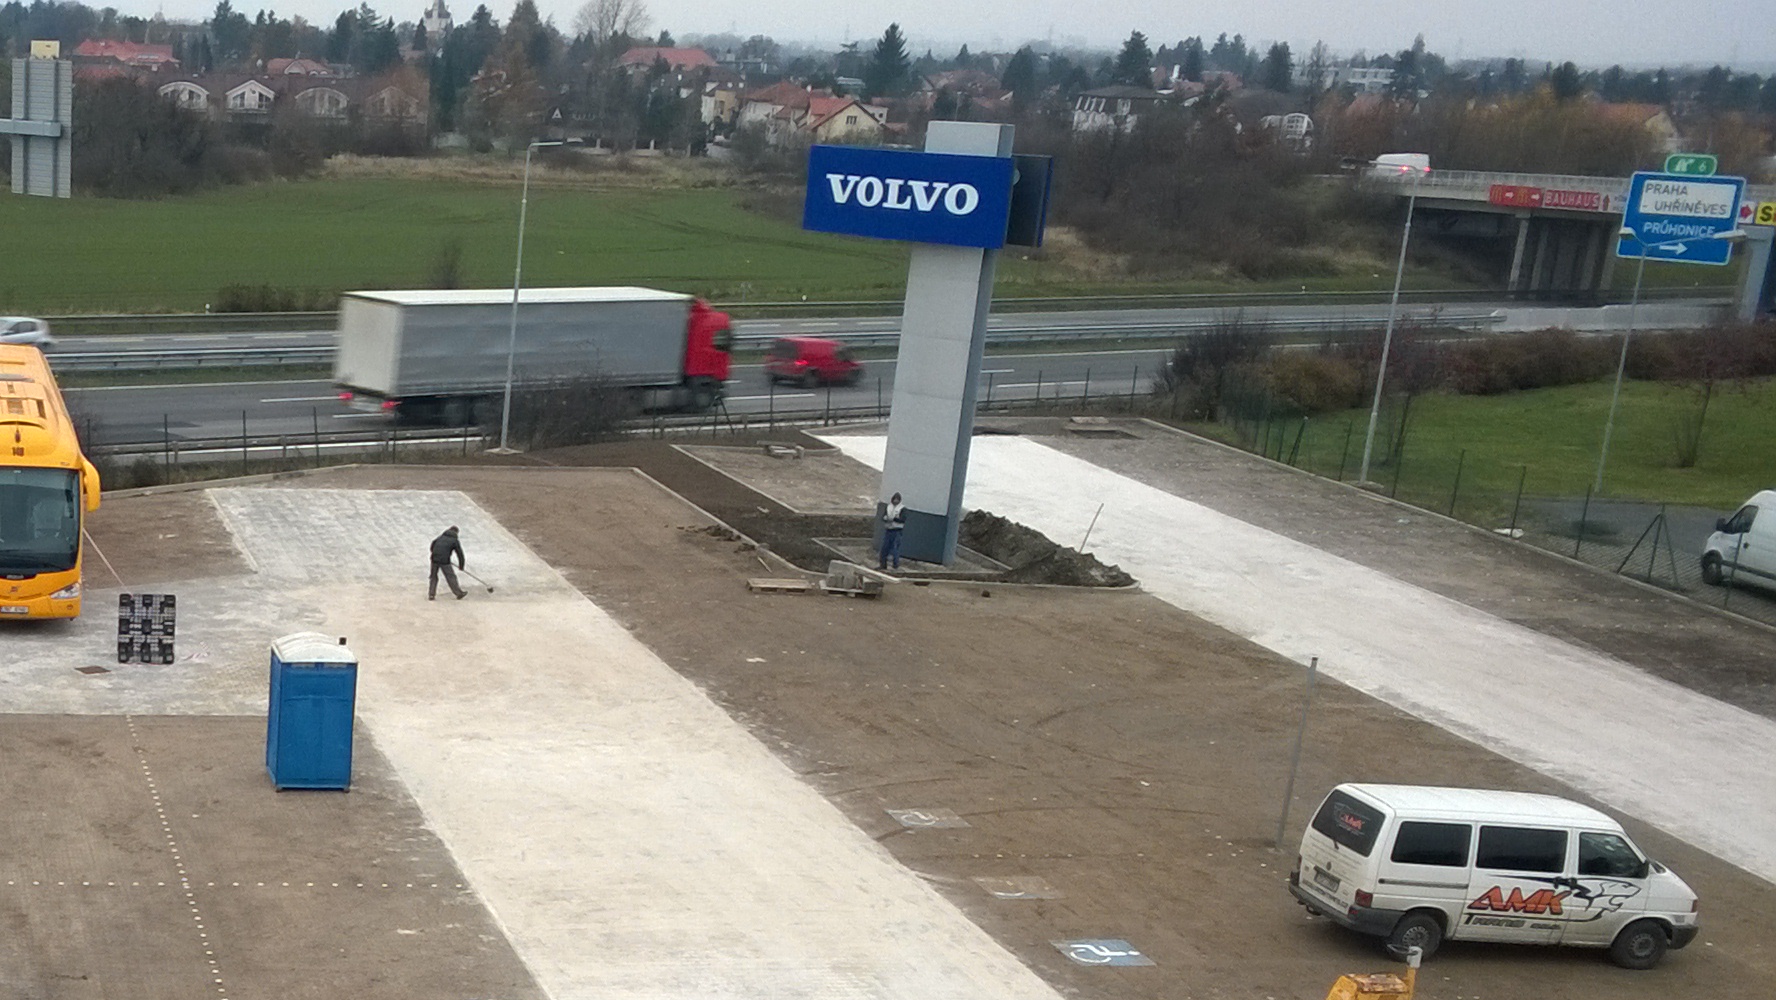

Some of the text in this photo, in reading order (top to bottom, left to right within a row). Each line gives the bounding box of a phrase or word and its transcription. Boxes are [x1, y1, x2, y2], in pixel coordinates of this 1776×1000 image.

[1699, 161, 1706, 172] 6
[826, 173, 979, 215] VOLVO
[1645, 183, 1688, 196] PRAHA
[1545, 191, 1600, 208] BAUHAUS
[1467, 885, 1573, 915] AMK
